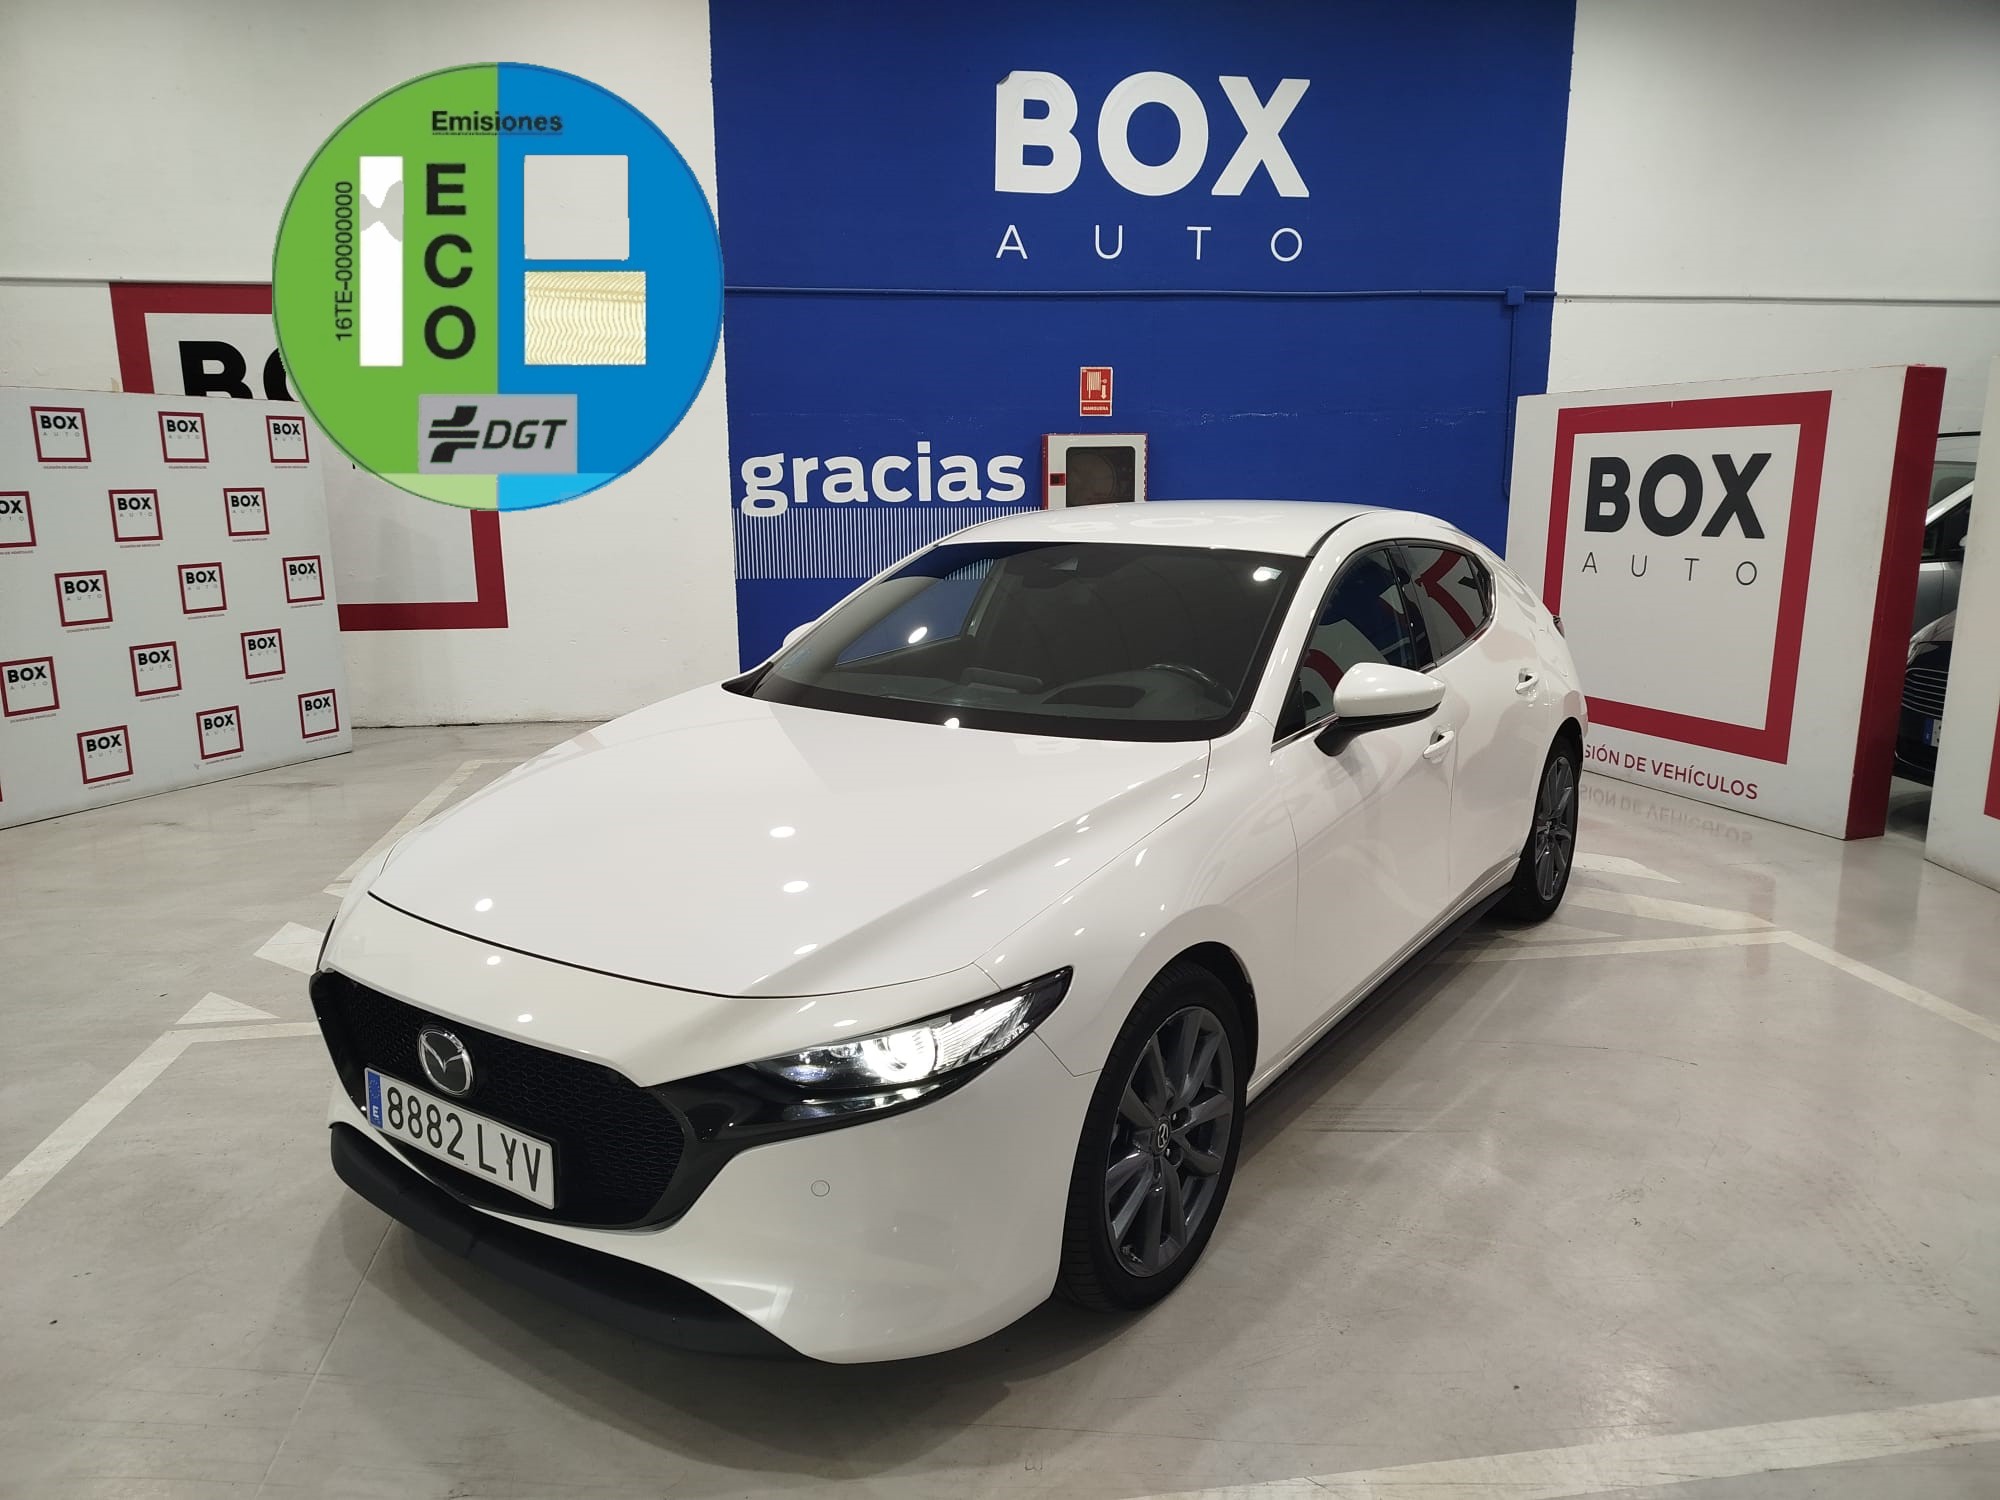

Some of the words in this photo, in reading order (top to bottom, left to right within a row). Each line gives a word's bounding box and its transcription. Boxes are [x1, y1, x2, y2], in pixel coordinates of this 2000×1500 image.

[995, 70, 1311, 198] BOX
[995, 224, 1303, 262] AUTO
[40, 415, 79, 429] BOX
[166, 419, 199, 432] BOX
[273, 423, 300, 435] BOX
[741, 440, 1026, 518] gracias
[231, 495, 260, 507] BOX
[1584, 452, 1772, 539] BOX
[117, 497, 152, 510] BOX
[289, 562, 316, 575] BOX
[1581, 551, 1758, 586] AUTO
[186, 570, 217, 584] BOX
[64, 579, 101, 594] BOX
[248, 636, 277, 650] BOX
[137, 650, 171, 665] BOX
[7, 666, 47, 683] BOX
[305, 696, 331, 711] BOX
[204, 714, 234, 730] BOX
[86, 734, 122, 752] BOX
[1624, 753, 1647, 773] DE
[1651, 759, 1758, 800] VEHÍCULOS
[387, 1086, 465, 1161] 8882
[477, 1123, 541, 1192] LYV
